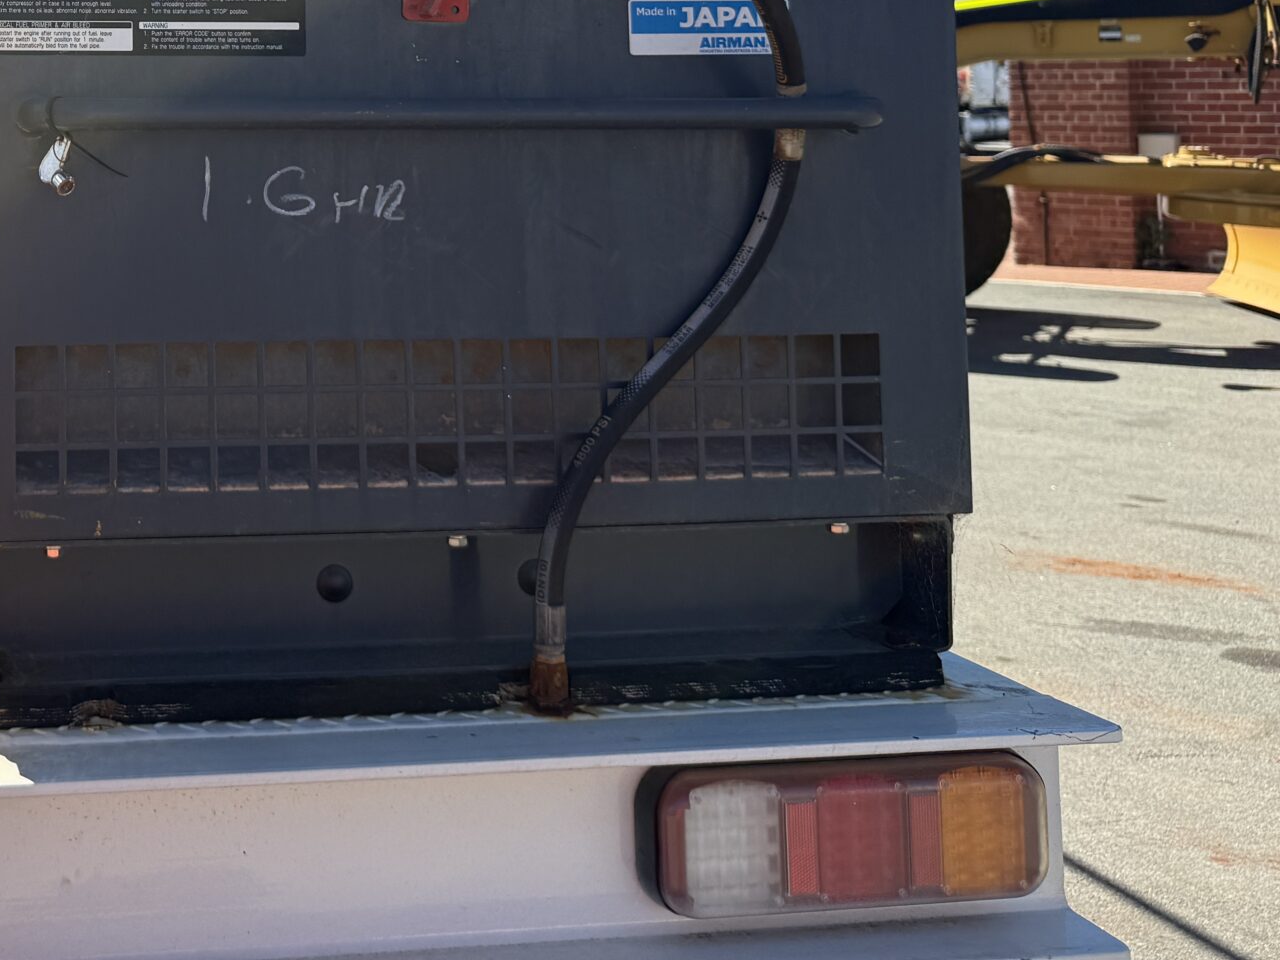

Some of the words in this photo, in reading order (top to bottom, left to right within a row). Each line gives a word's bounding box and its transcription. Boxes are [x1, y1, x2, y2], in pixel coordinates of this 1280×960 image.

[636, 7, 664, 16] Made
[666, 7, 676, 16] in
[700, 37, 765, 48] AIRMAN
[592, 415, 612, 437] PSI
[536, 560, 549, 606] (DN10)
